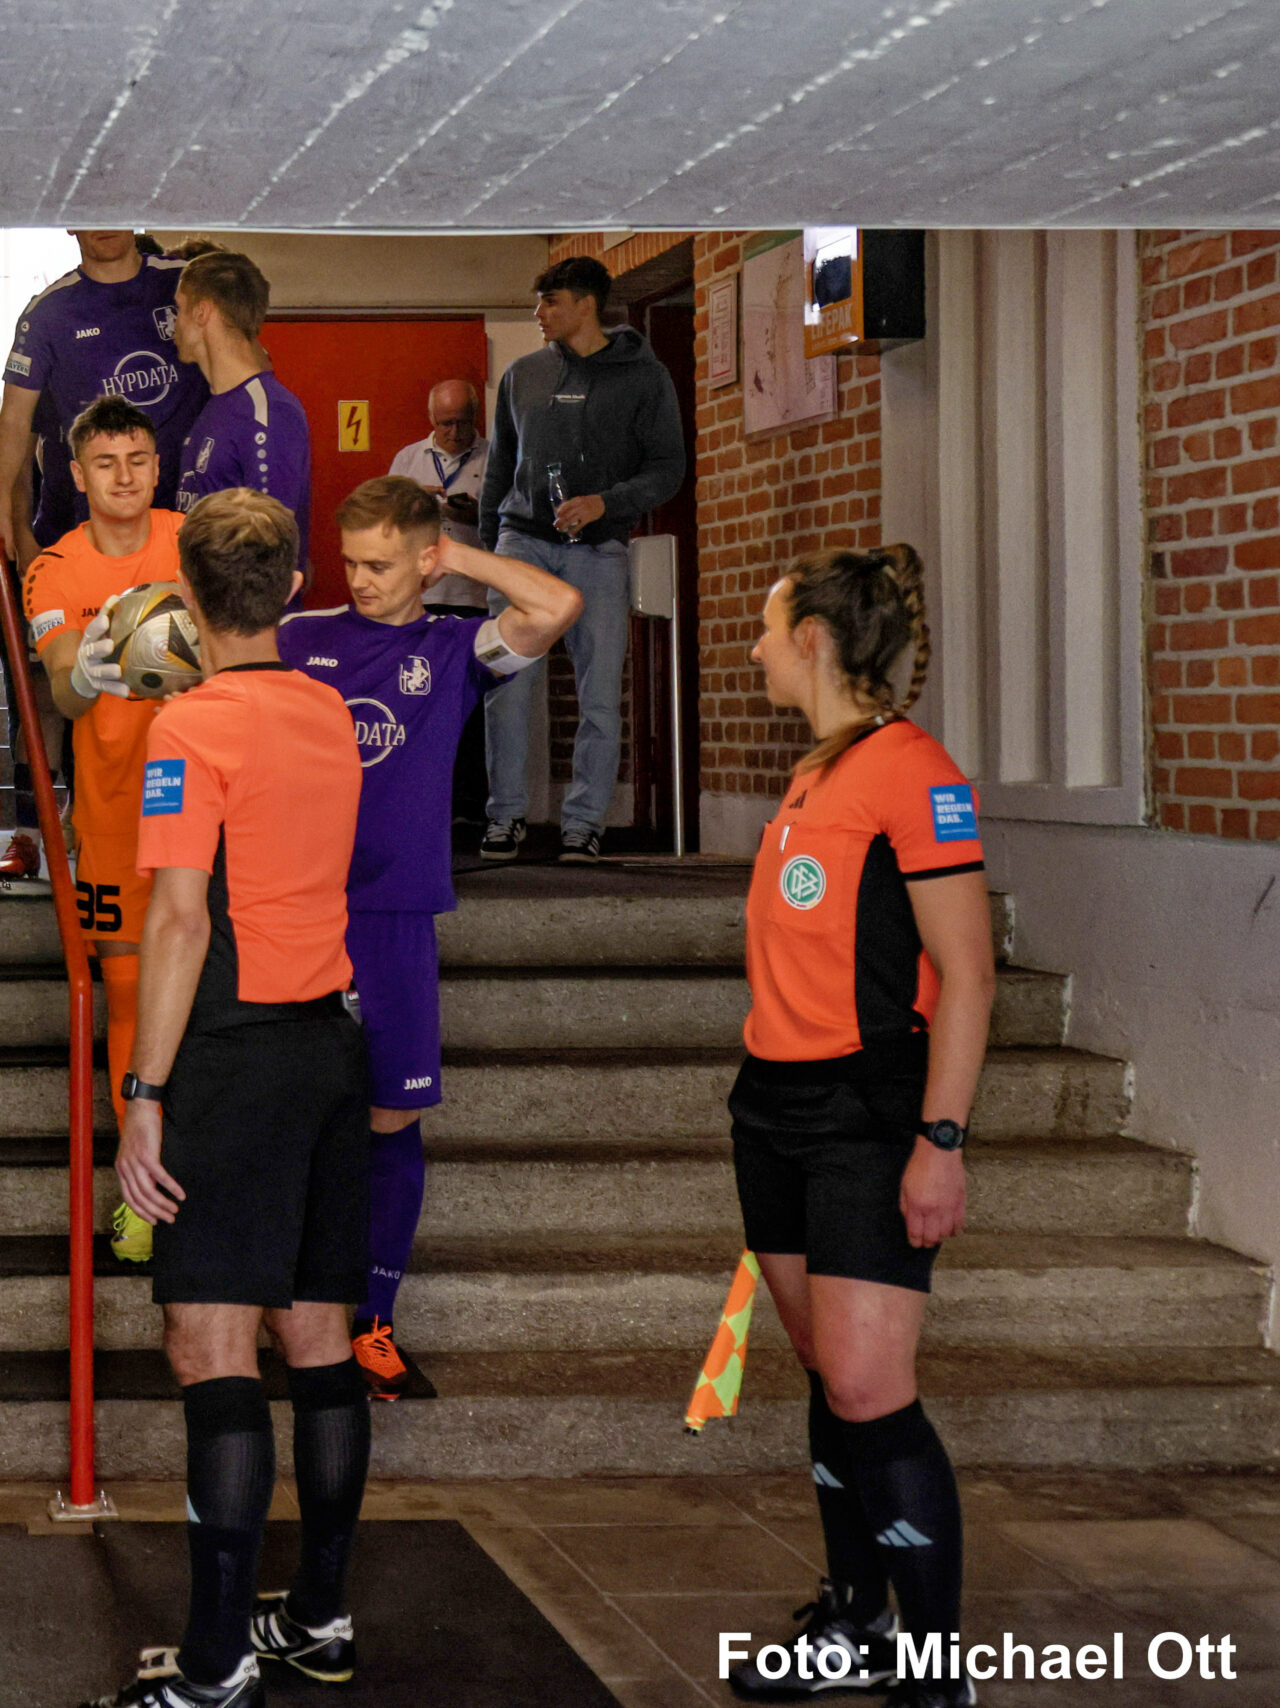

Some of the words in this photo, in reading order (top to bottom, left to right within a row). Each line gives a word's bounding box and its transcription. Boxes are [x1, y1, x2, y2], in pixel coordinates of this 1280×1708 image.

[76, 327, 101, 340] JAKO
[102, 364, 179, 398] HYPDATA
[81, 607, 102, 618] JAK
[306, 656, 339, 668] JAKO
[356, 721, 407, 747] DATA
[147, 767, 163, 778] WIR
[146, 776, 182, 789] REGELN
[933, 793, 956, 803] WIR
[403, 1076, 432, 1091] JAKO
[372, 1265, 401, 1280] JAKO
